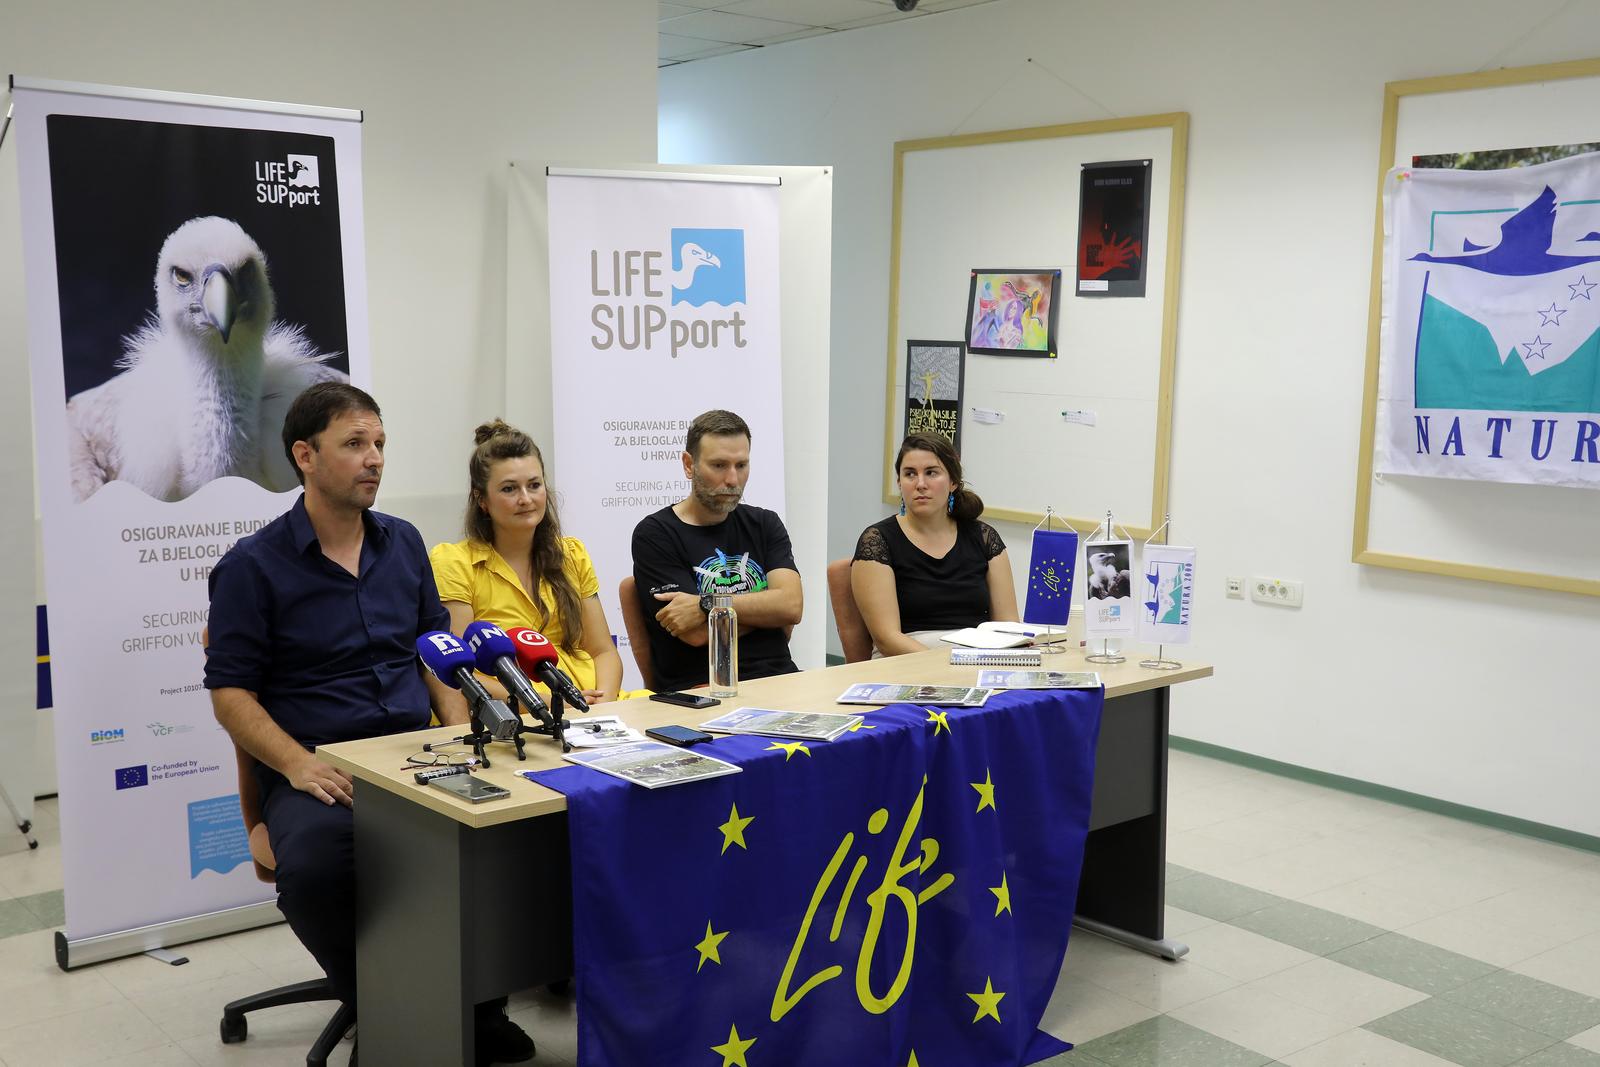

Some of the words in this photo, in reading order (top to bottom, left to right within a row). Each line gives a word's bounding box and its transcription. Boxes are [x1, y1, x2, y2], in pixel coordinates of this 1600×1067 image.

[255, 160, 287, 183] LIFE
[256, 183, 321, 208] SUPport
[590, 249, 664, 297] LIFE
[590, 303, 748, 359] SUPport
[603, 420, 677, 431] OSIGURAVANJE
[614, 436, 628, 446] ZA
[641, 451, 648, 461] U
[650, 450, 682, 461] HRVAT
[615, 480, 663, 492] SECURING
[665, 480, 673, 490] A
[601, 496, 643, 508] GRIFFON
[121, 521, 230, 542] OSIGURAVANJE
[234, 516, 275, 535] BUD
[138, 549, 158, 563] ZA
[162, 542, 235, 561] BJELOGLA
[180, 567, 190, 581] U
[1181, 586, 1191, 626] NATURA
[122, 633, 184, 653] GRIFFON
[160, 686, 183, 696] Project
[184, 684, 205, 693] 10107
[153, 726, 174, 737] VCF
[151, 760, 188, 772] Co-funded
[189, 759, 198, 767] by
[164, 768, 198, 778] European
[199, 765, 220, 773] Union
